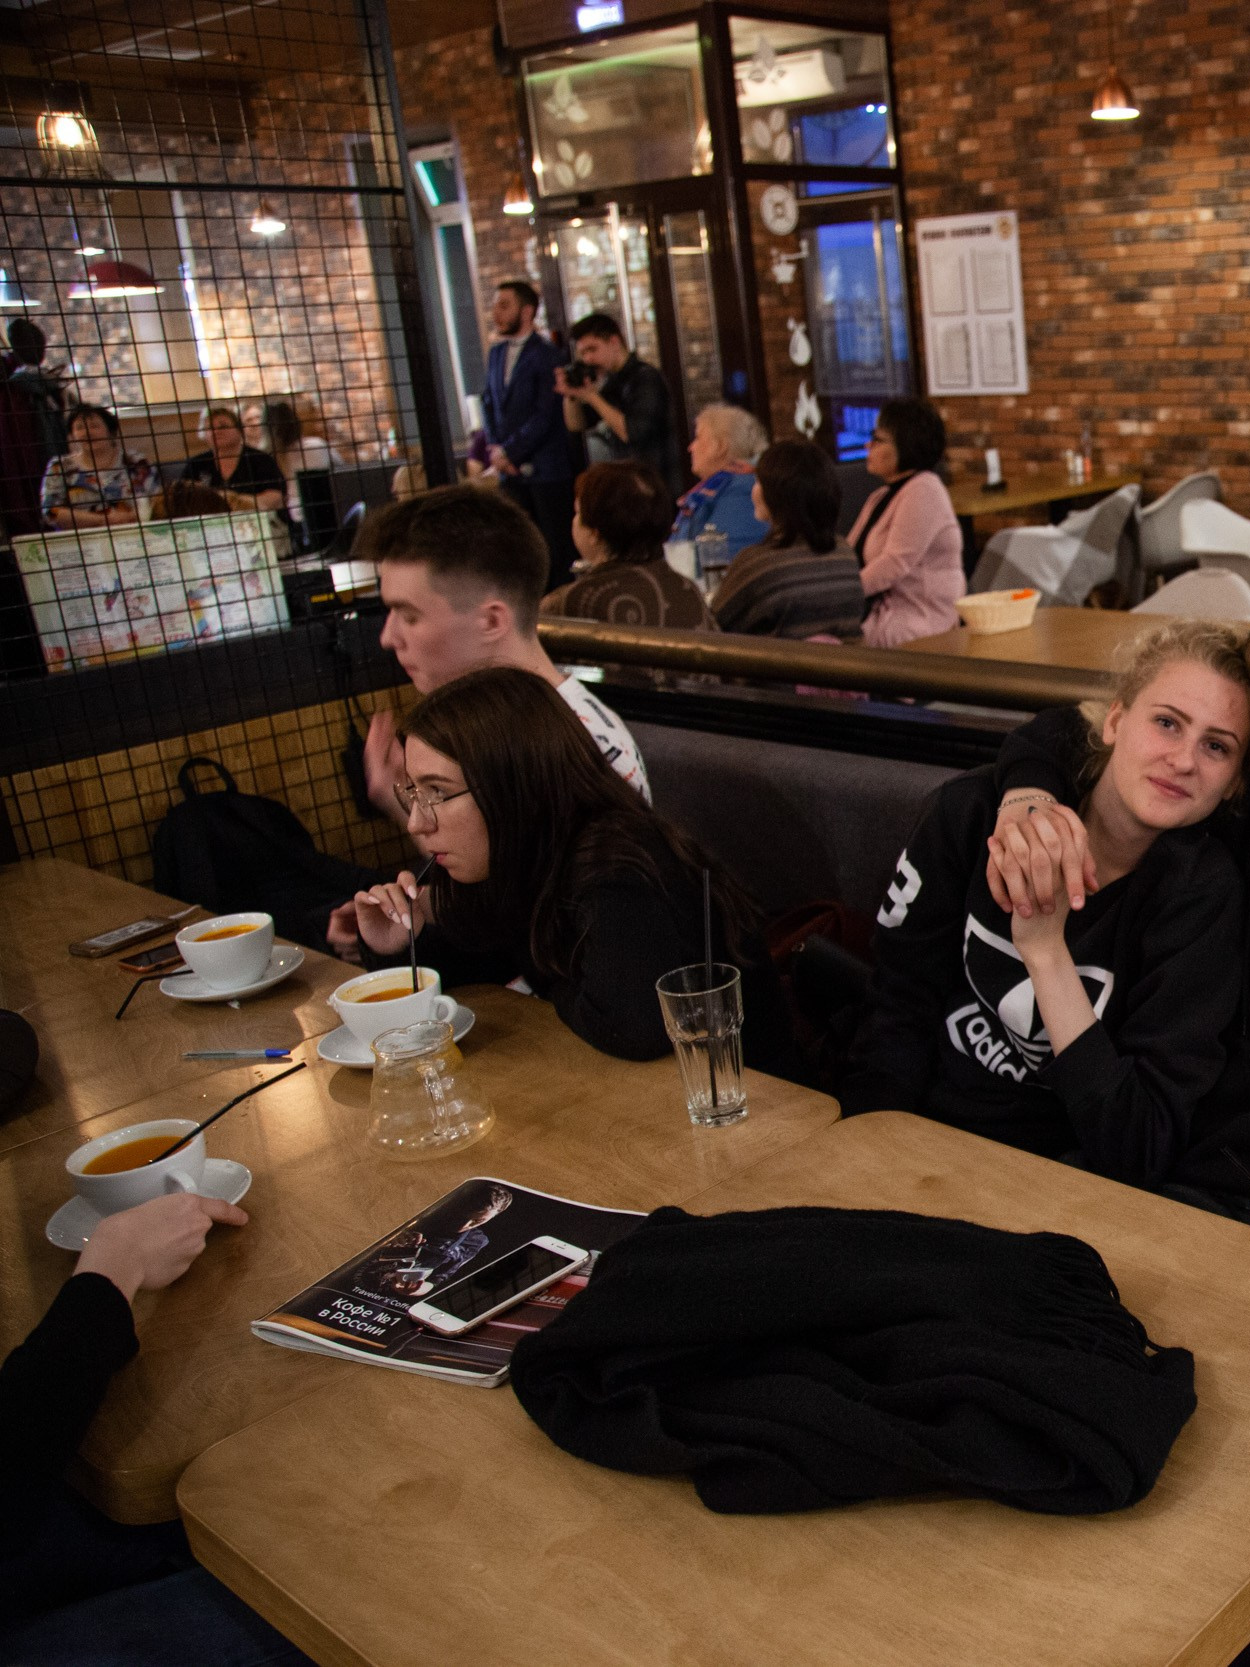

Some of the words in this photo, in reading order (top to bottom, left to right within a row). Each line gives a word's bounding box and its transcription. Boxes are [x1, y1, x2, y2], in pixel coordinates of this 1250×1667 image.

[351, 1286, 391, 1303] Traveler's
[331, 1297, 373, 1317] Кофе
[317, 1308, 330, 1319] в
[328, 1311, 387, 1337] России
